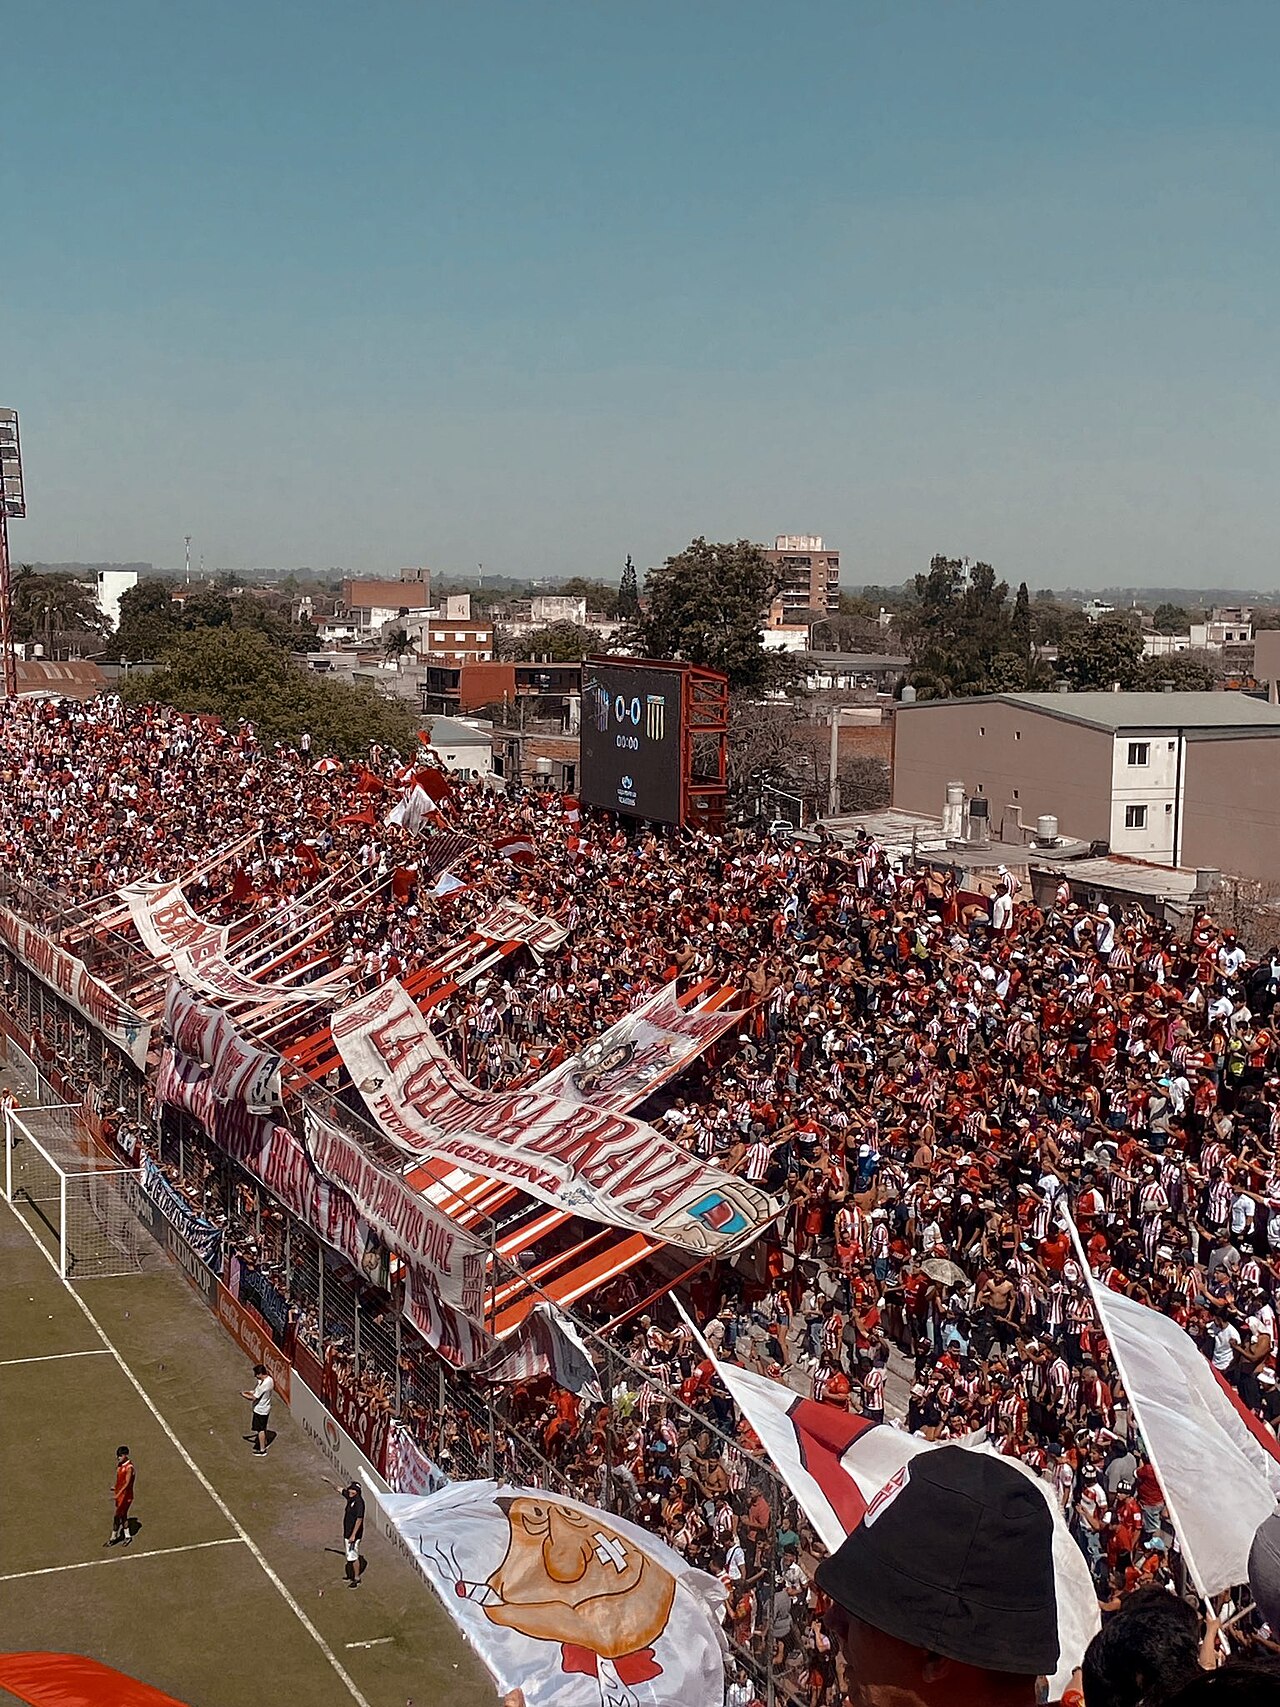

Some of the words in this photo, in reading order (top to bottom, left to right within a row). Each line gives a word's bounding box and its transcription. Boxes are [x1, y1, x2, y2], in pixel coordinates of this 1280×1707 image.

[616, 734, 639, 750] 00:00
[524, 1107, 707, 1219] BRAVA
[423, 1219, 454, 1273] DIAZ
